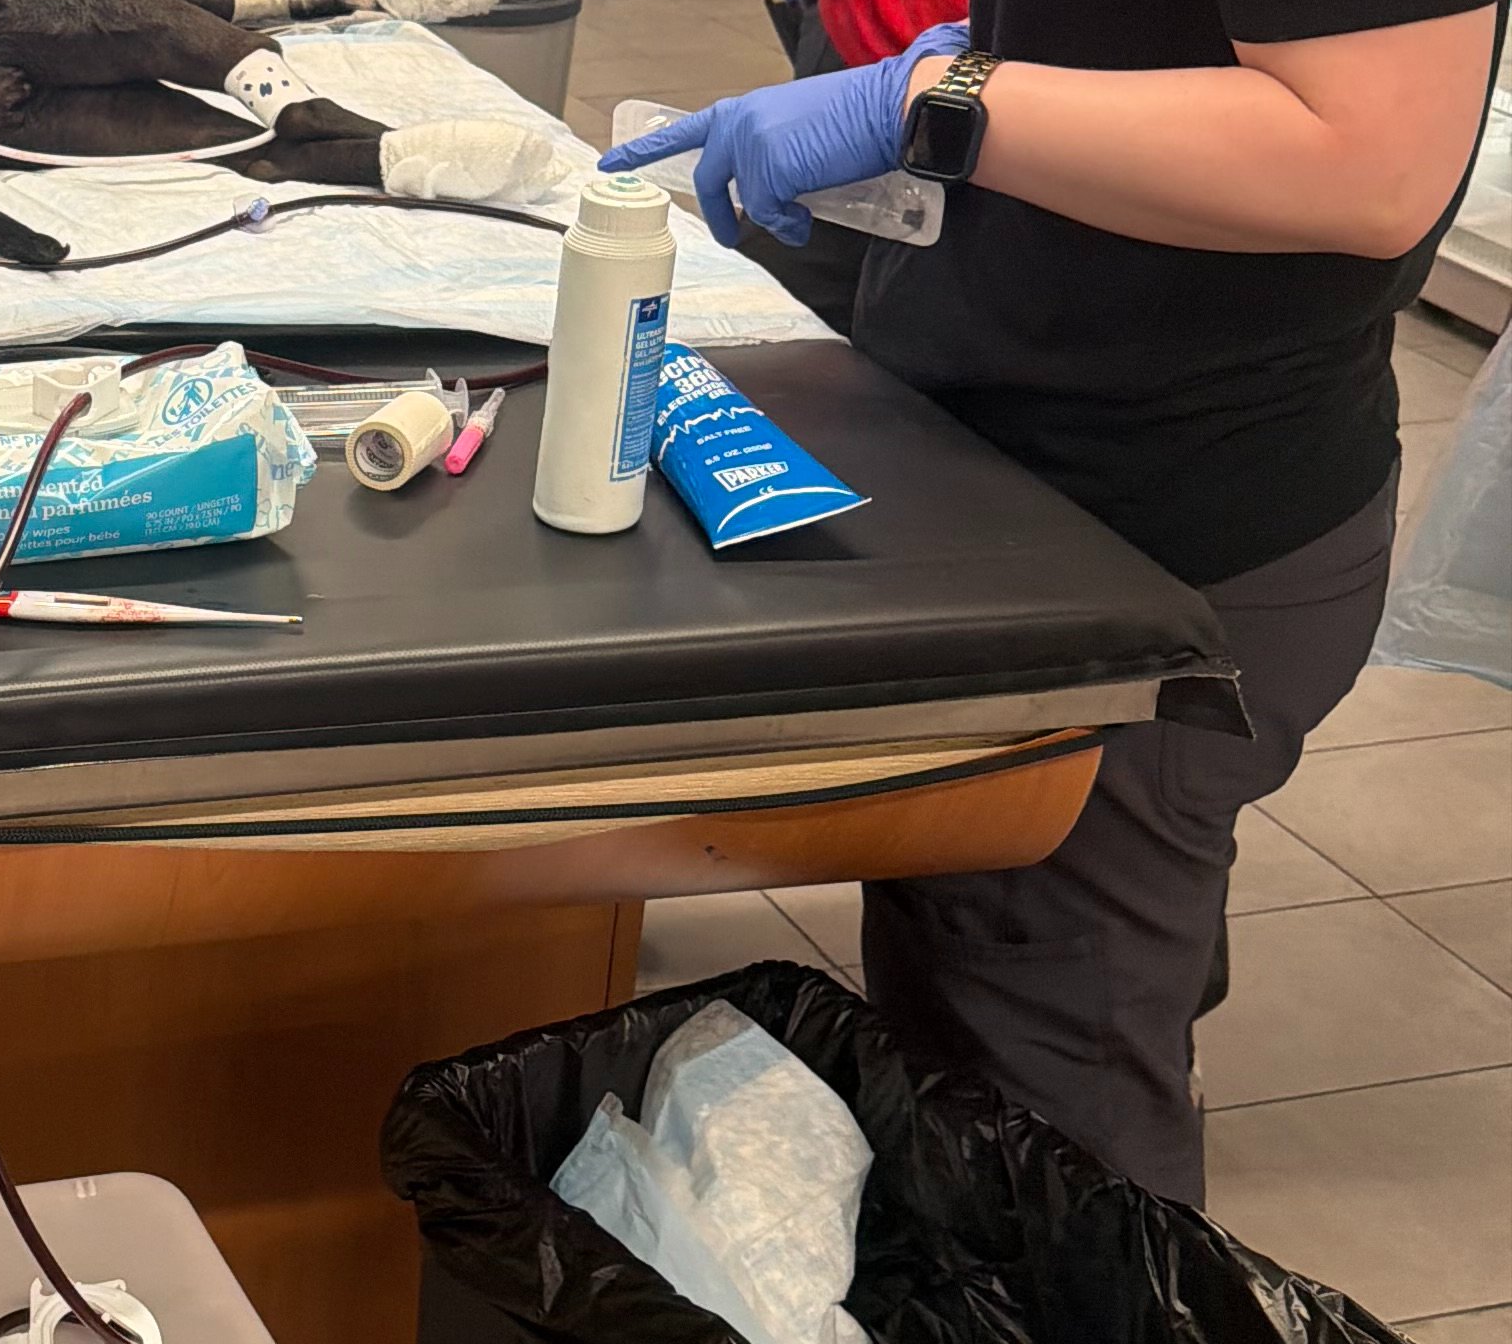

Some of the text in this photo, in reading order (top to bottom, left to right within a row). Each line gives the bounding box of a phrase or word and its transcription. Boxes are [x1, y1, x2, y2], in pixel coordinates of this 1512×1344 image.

[674, 368, 722, 394] 360
[154, 382, 259, 447] LES TOILETTES
[696, 425, 752, 445] SALT FREE
[722, 463, 785, 486] PARKER
[42, 489, 153, 521] parfumées
[145, 512, 158, 520] 90
[159, 506, 189, 518] COUNT
[197, 494, 240, 511] LINGETTES
[32, 526, 71, 538] wipes
[55, 535, 86, 547] pour
[88, 530, 121, 542] bébé
